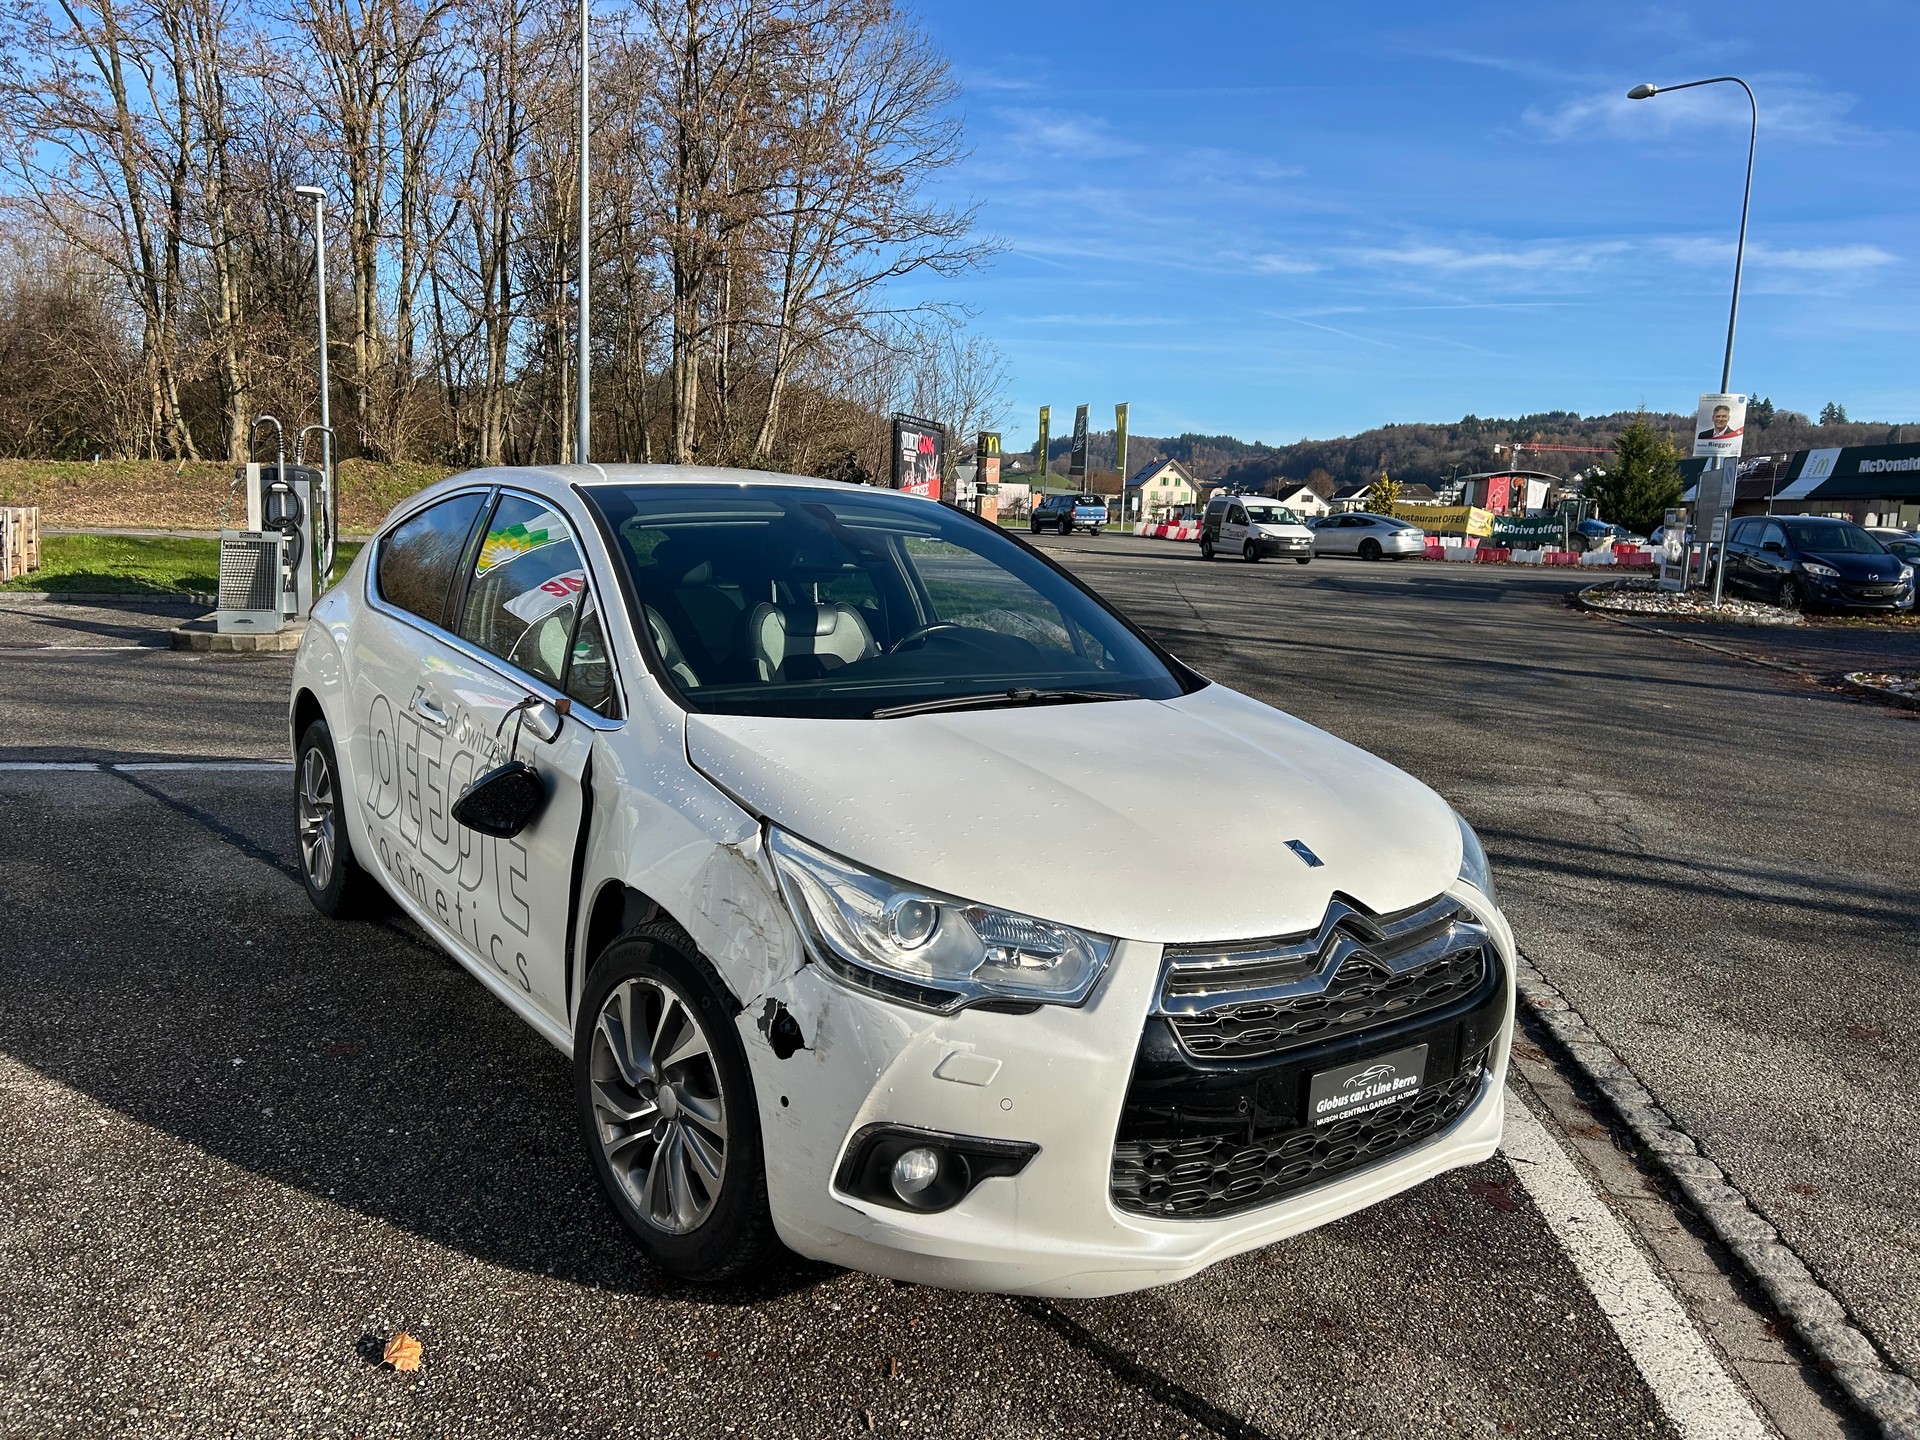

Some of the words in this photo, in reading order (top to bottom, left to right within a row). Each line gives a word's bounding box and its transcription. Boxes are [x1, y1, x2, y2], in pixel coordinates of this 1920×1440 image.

[1395, 512, 1443, 524] Restaurant
[1442, 514, 1466, 524] OFFEN
[1493, 523, 1534, 535] McDrive
[1537, 523, 1563, 534] offen
[445, 705, 461, 738] of
[367, 823, 532, 994] cosmetics
[1316, 1094, 1349, 1113] Globus
[1349, 1090, 1365, 1104] car
[1365, 1085, 1373, 1098] S
[1372, 1082, 1391, 1097] Line
[1392, 1075, 1417, 1091] Berro
[1316, 1114, 1339, 1126] MUSCH
[1396, 1088, 1420, 1101] ALTDORF
